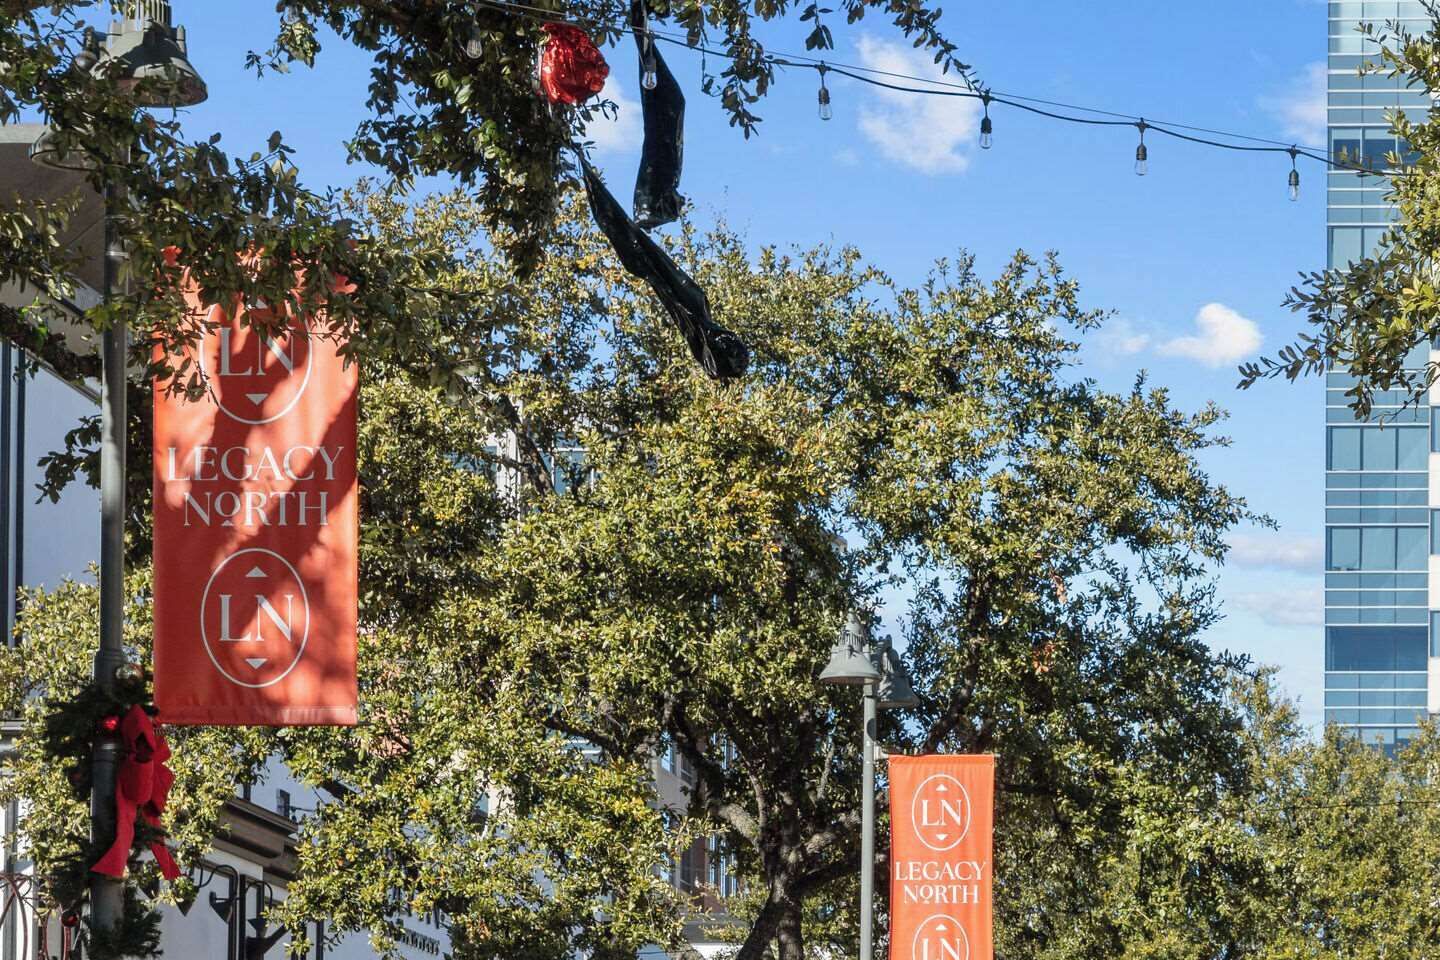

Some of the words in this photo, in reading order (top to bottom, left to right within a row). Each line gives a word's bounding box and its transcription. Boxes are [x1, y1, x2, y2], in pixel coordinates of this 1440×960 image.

[166, 444, 345, 483] LEGACY
[183, 490, 329, 527] NORTH
[217, 594, 295, 644] LN
[922, 800, 961, 825] LN
[895, 861, 986, 883] LEGACY
[903, 884, 979, 905] NORTH
